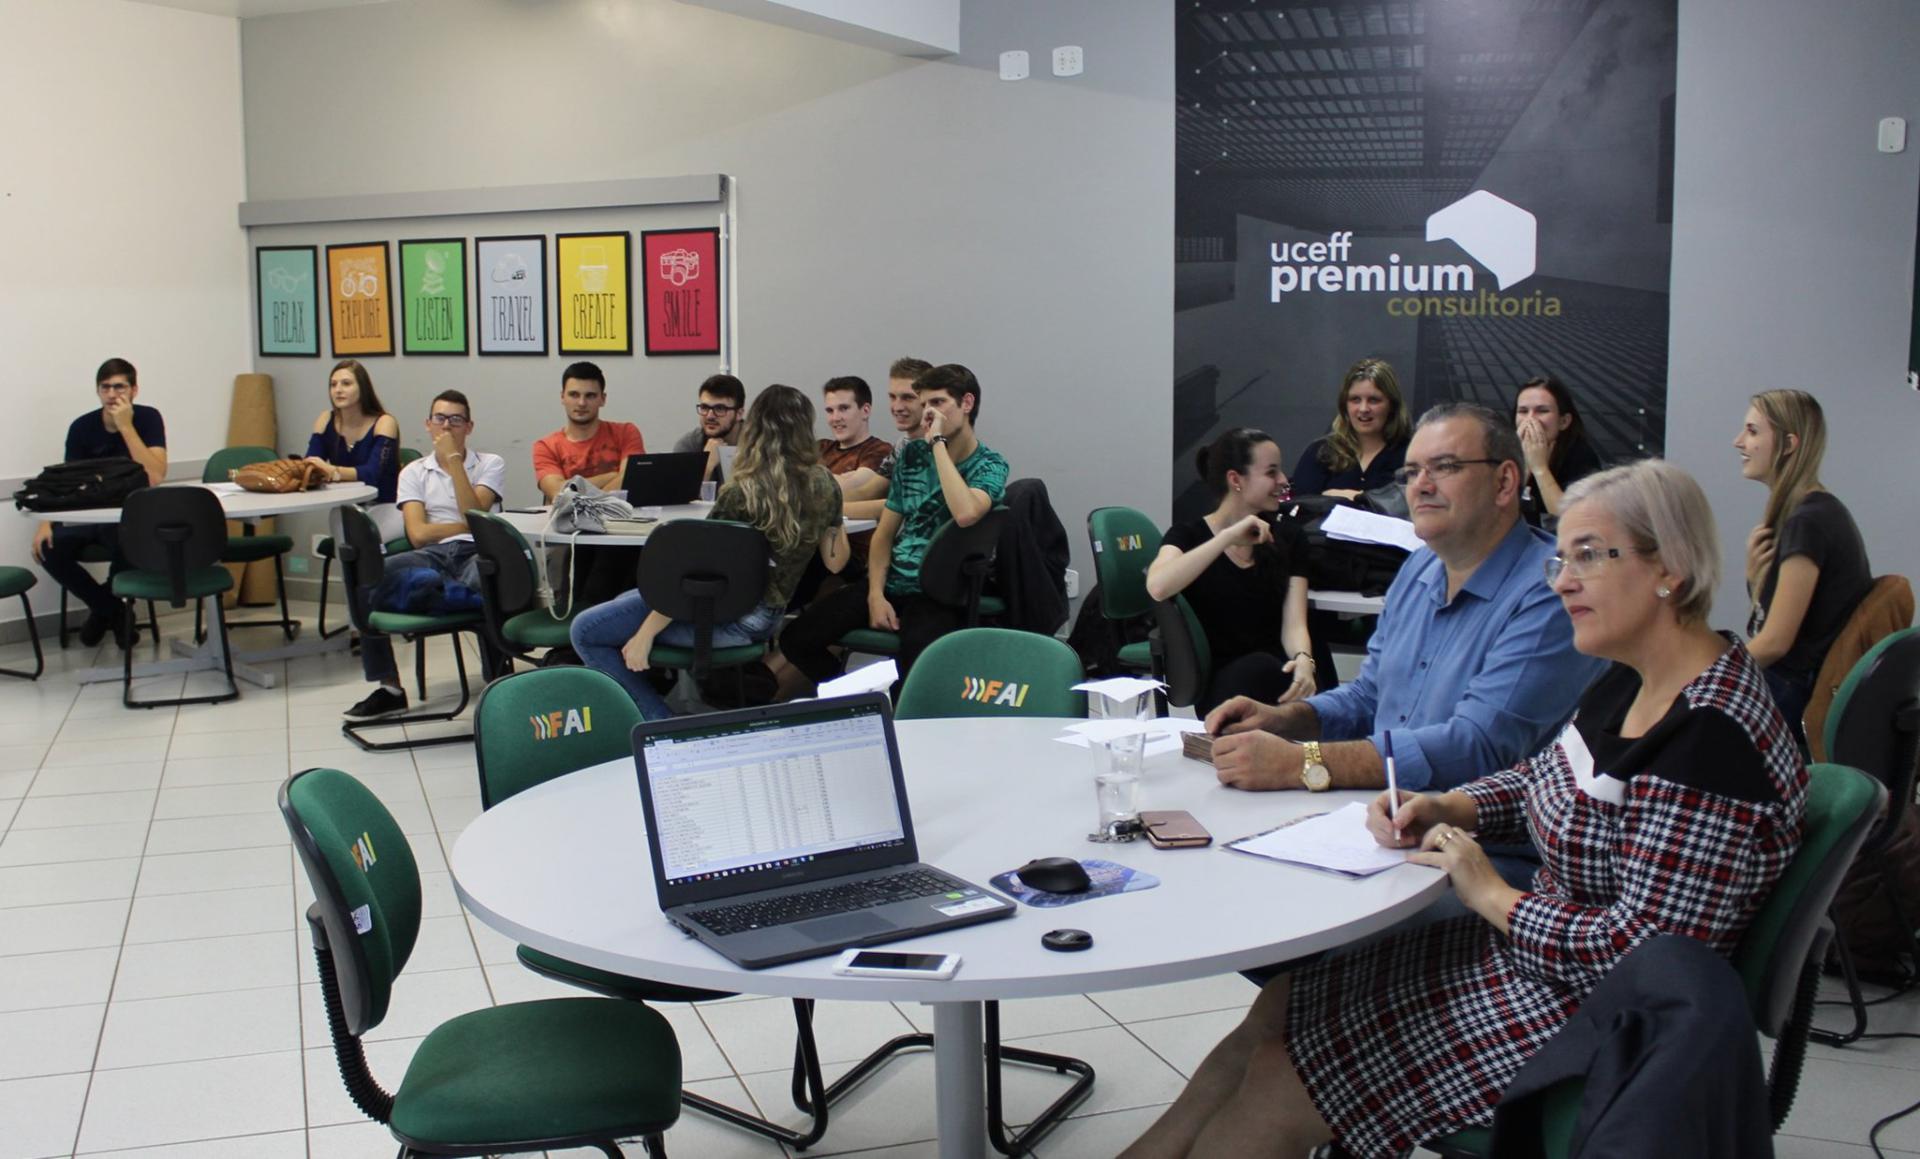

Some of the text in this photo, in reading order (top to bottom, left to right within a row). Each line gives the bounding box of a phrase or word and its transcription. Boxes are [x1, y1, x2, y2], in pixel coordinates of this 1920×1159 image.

[1271, 232, 1353, 262] uceff
[1271, 254, 1474, 302] premium
[273, 301, 305, 343] RELAX
[416, 297, 453, 340] LISTEN
[491, 296, 536, 341] TRAVEL
[573, 293, 616, 339] CREATE
[663, 289, 702, 337] SMILE
[1388, 289, 1561, 317] consultoria
[981, 680, 1029, 707] FAI
[549, 706, 592, 738] FAI
